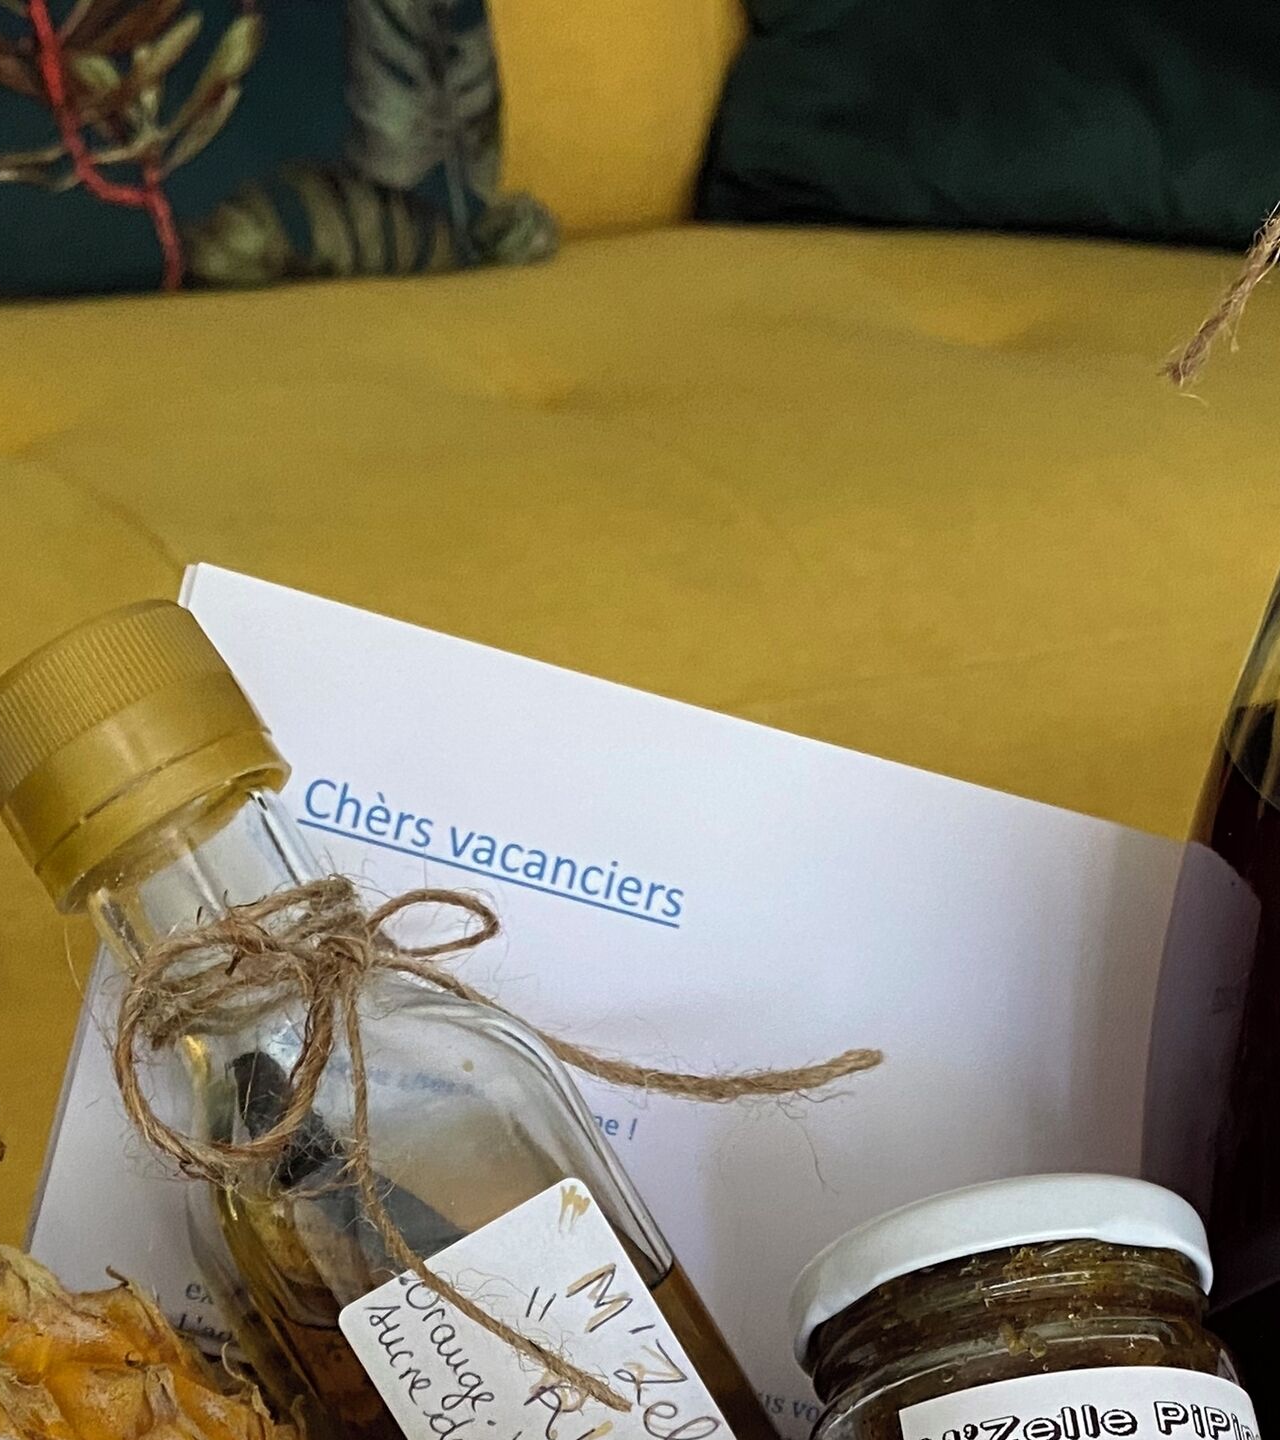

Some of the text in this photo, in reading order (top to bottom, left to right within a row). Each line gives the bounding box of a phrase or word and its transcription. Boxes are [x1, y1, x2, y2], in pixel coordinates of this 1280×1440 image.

[304, 779, 684, 918] Chèrs vacanciers
[364, 1306, 431, 1406] sucre
